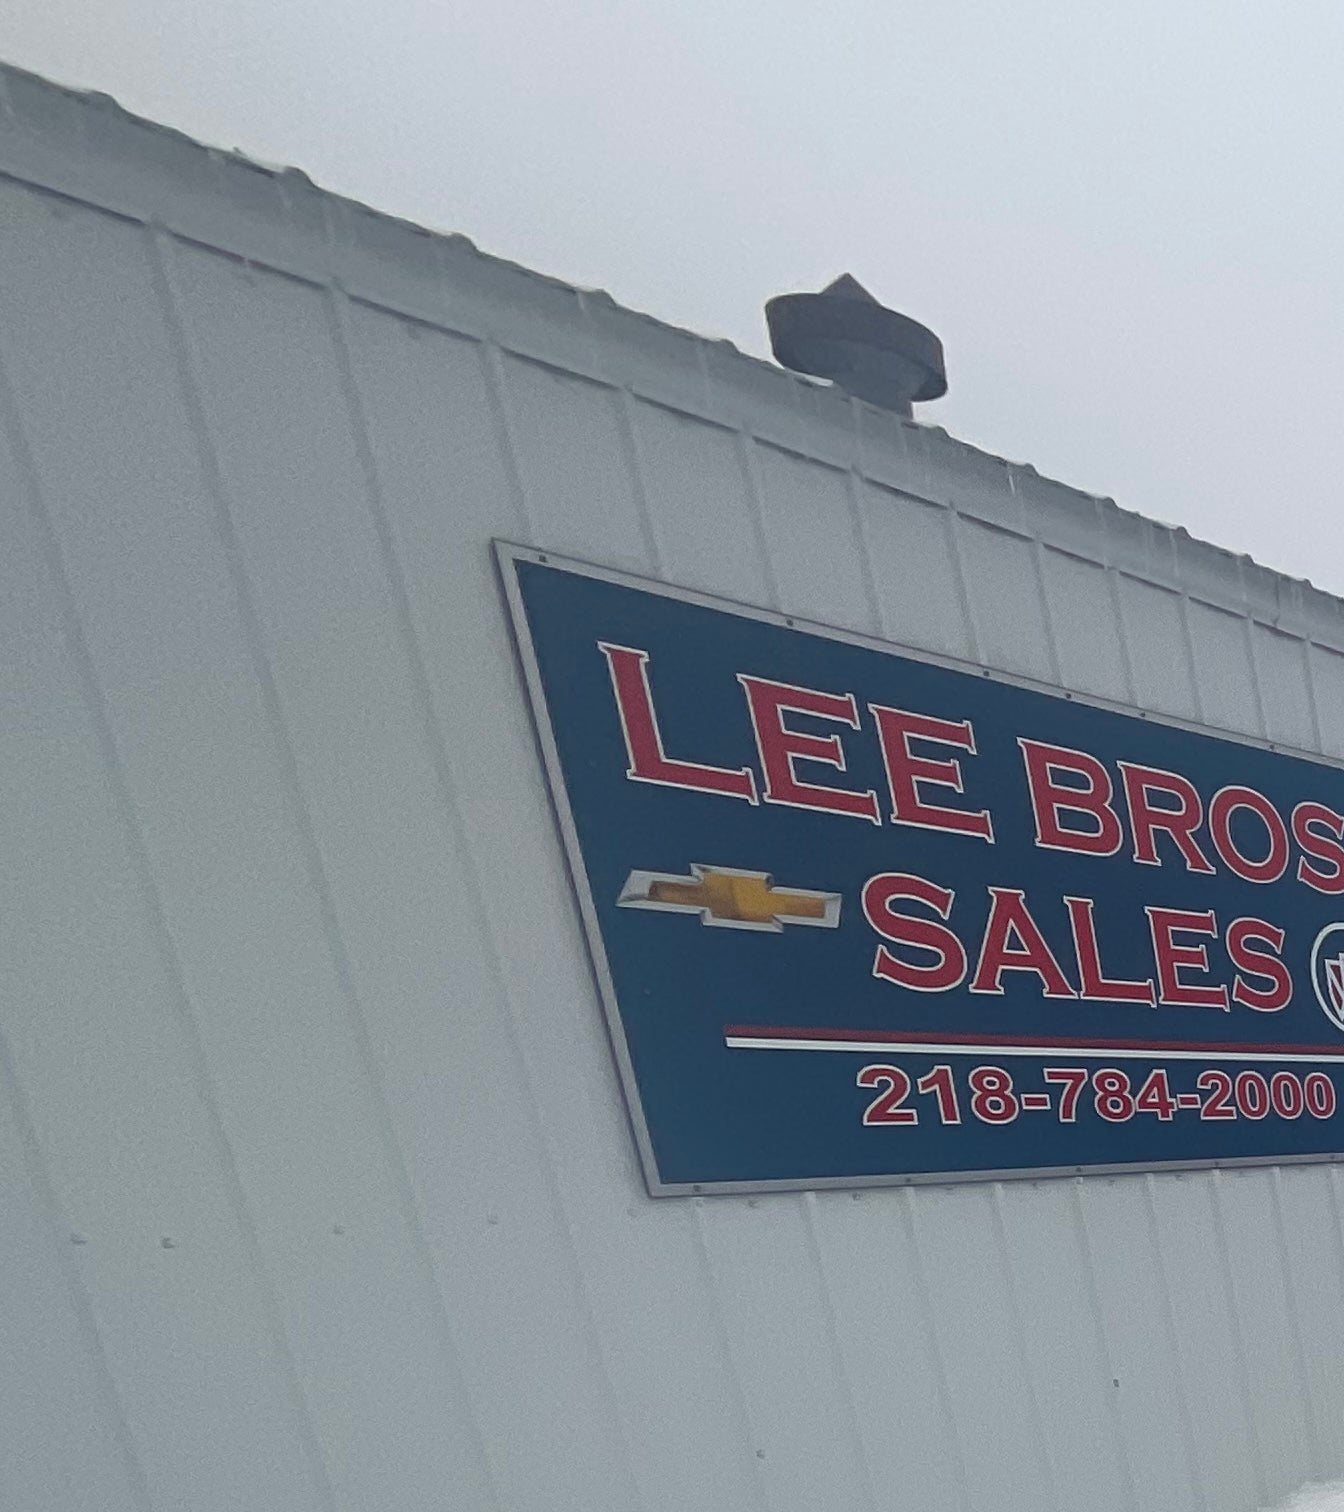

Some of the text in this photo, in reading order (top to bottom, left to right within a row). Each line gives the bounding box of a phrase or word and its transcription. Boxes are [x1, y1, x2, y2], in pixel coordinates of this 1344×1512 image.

[597, 640, 996, 844] LEE
[861, 872, 1294, 1013] SALES
[856, 1064, 1337, 1127] 218-784-2000
